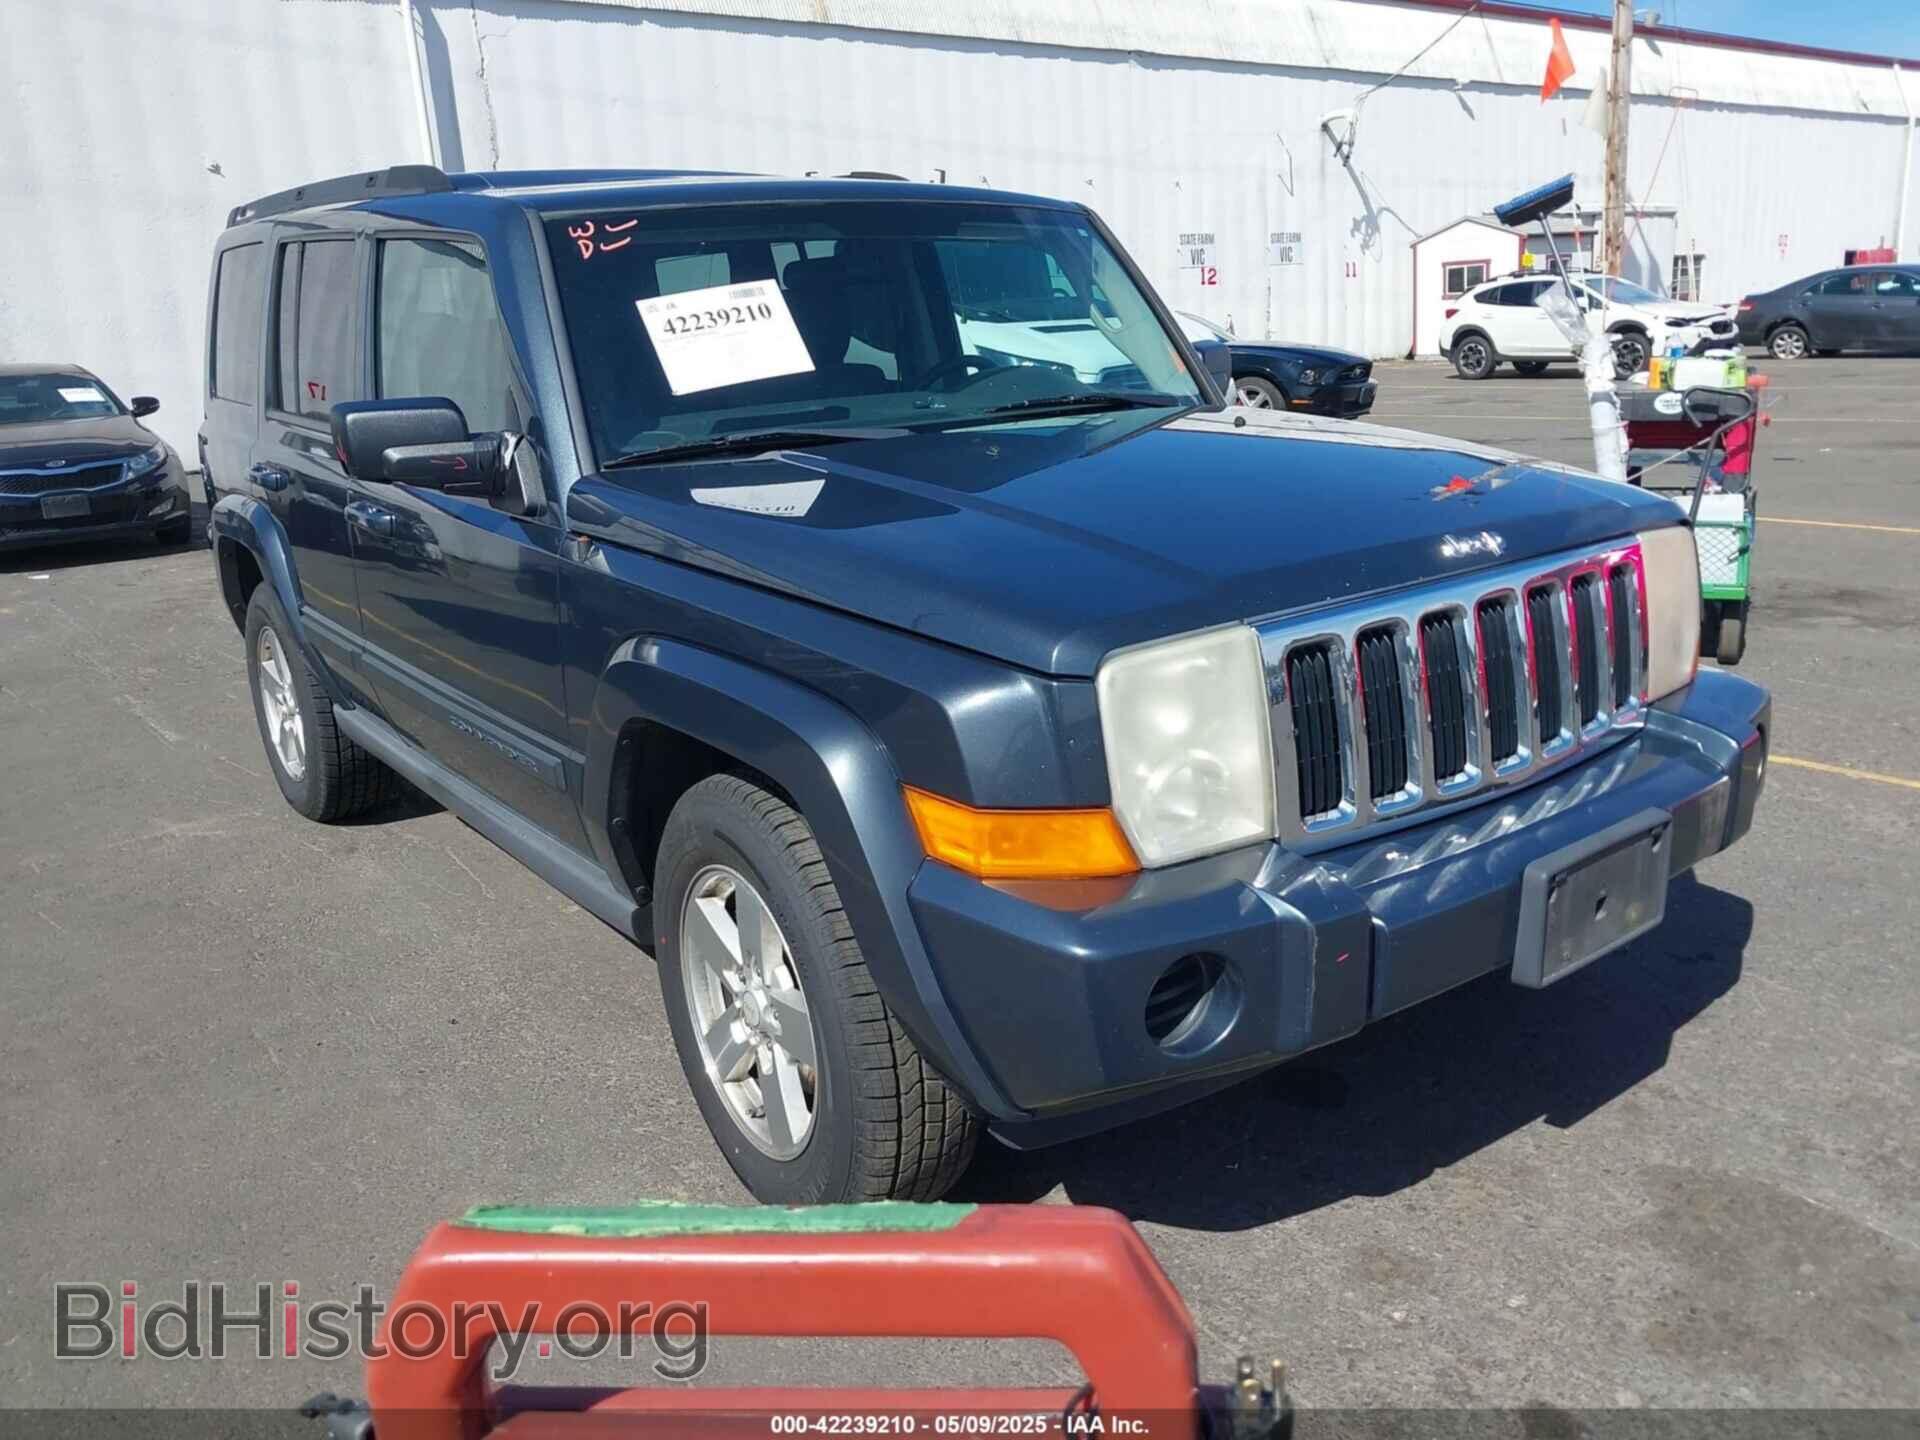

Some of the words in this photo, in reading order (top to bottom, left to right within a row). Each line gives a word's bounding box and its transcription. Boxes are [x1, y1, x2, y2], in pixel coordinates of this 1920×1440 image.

[1179, 233, 1197, 246] STATE
[1197, 233, 1215, 245] FARM
[1190, 247, 1206, 265] VIC
[1279, 246, 1293, 262] VIC
[1200, 267, 1217, 285] 12
[1345, 261, 1357, 278] 11
[663, 303, 772, 335] 42239210
